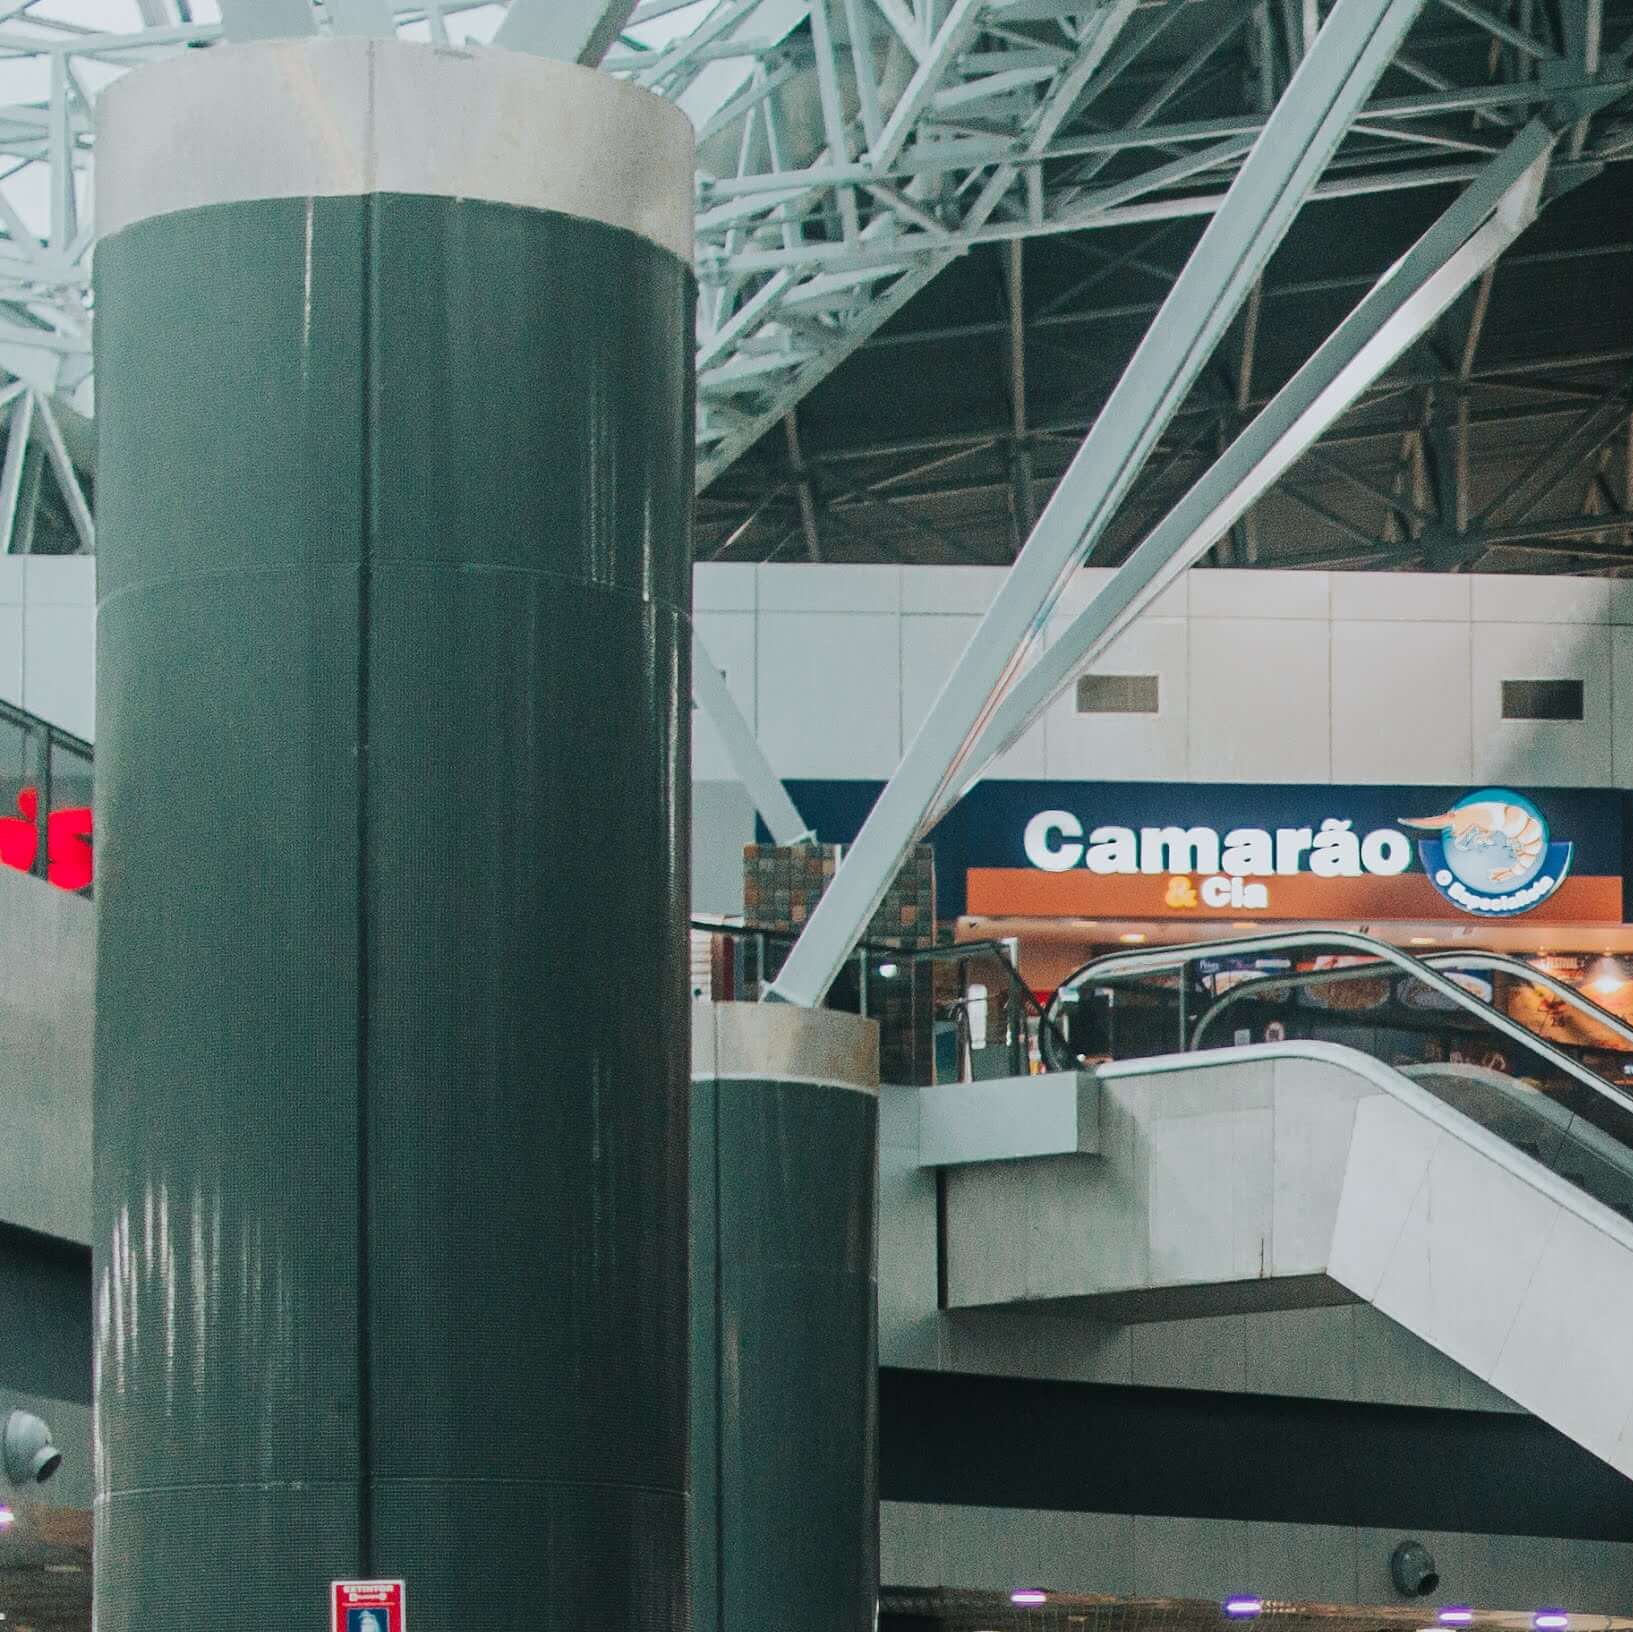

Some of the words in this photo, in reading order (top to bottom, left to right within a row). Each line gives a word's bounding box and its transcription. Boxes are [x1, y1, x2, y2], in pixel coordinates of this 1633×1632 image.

[1023, 809, 1412, 877] Camarão
[1165, 877, 1197, 909] &
[1201, 877, 1268, 909] Cia
